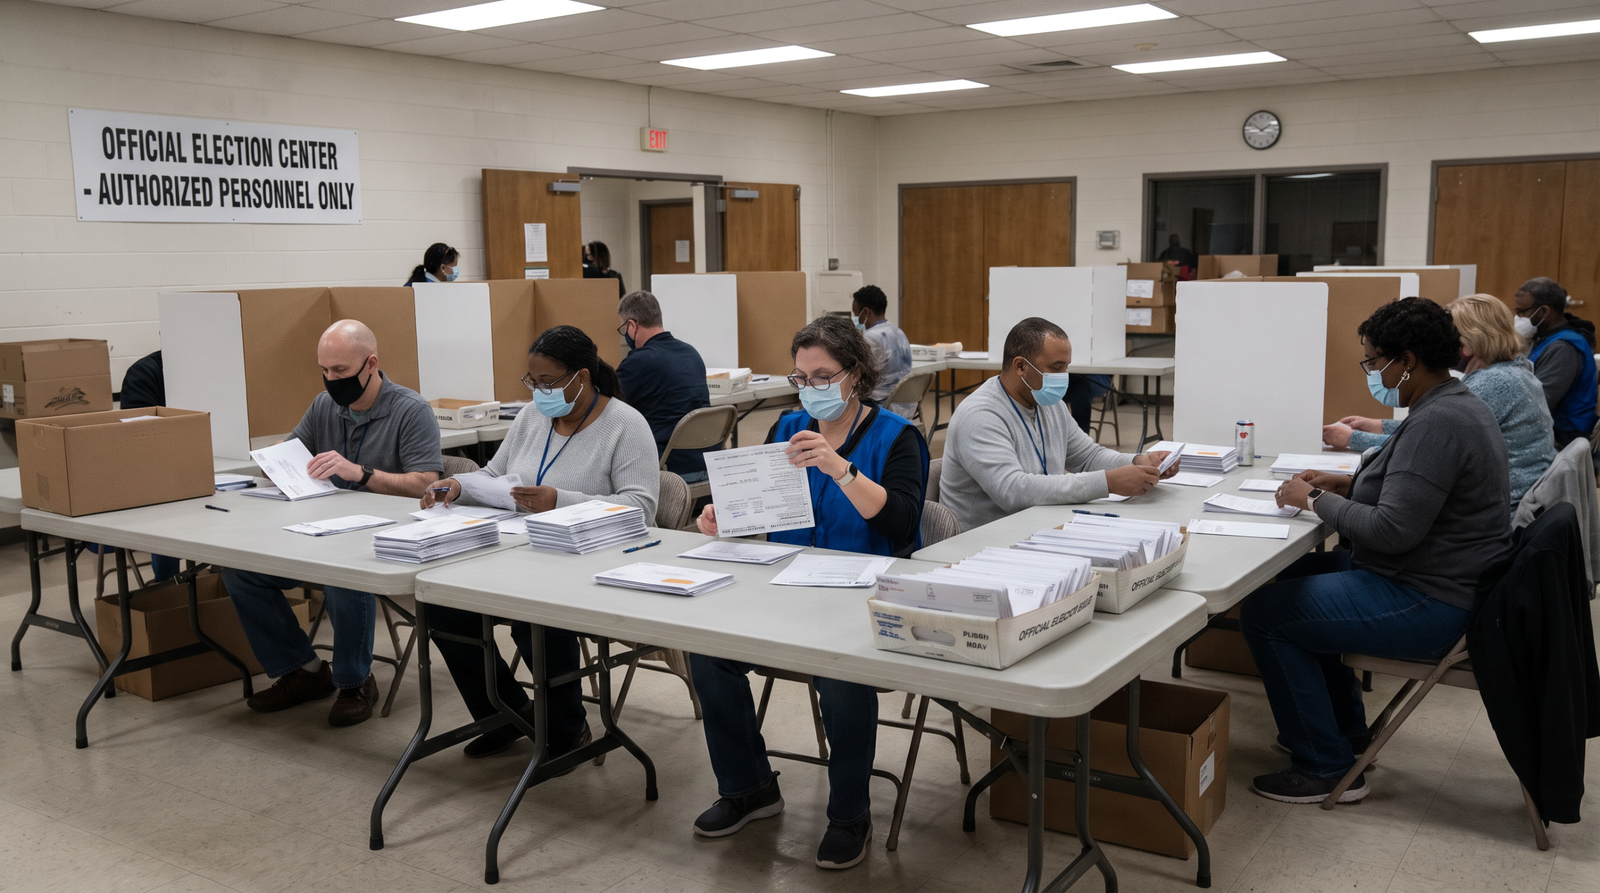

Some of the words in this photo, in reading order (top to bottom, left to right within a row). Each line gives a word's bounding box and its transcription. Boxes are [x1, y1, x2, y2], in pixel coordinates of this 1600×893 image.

[101, 126, 187, 163] OFFICIAL
[192, 132, 273, 168] ELECTION
[278, 138, 338, 170] CENTER
[649, 130, 667, 149] EXIT
[99, 172, 213, 207] AUTHORIZED
[219, 177, 314, 209] PERSONNEL
[318, 181, 355, 210] ONLY
[1018, 620, 1050, 641] OFFICIAL
